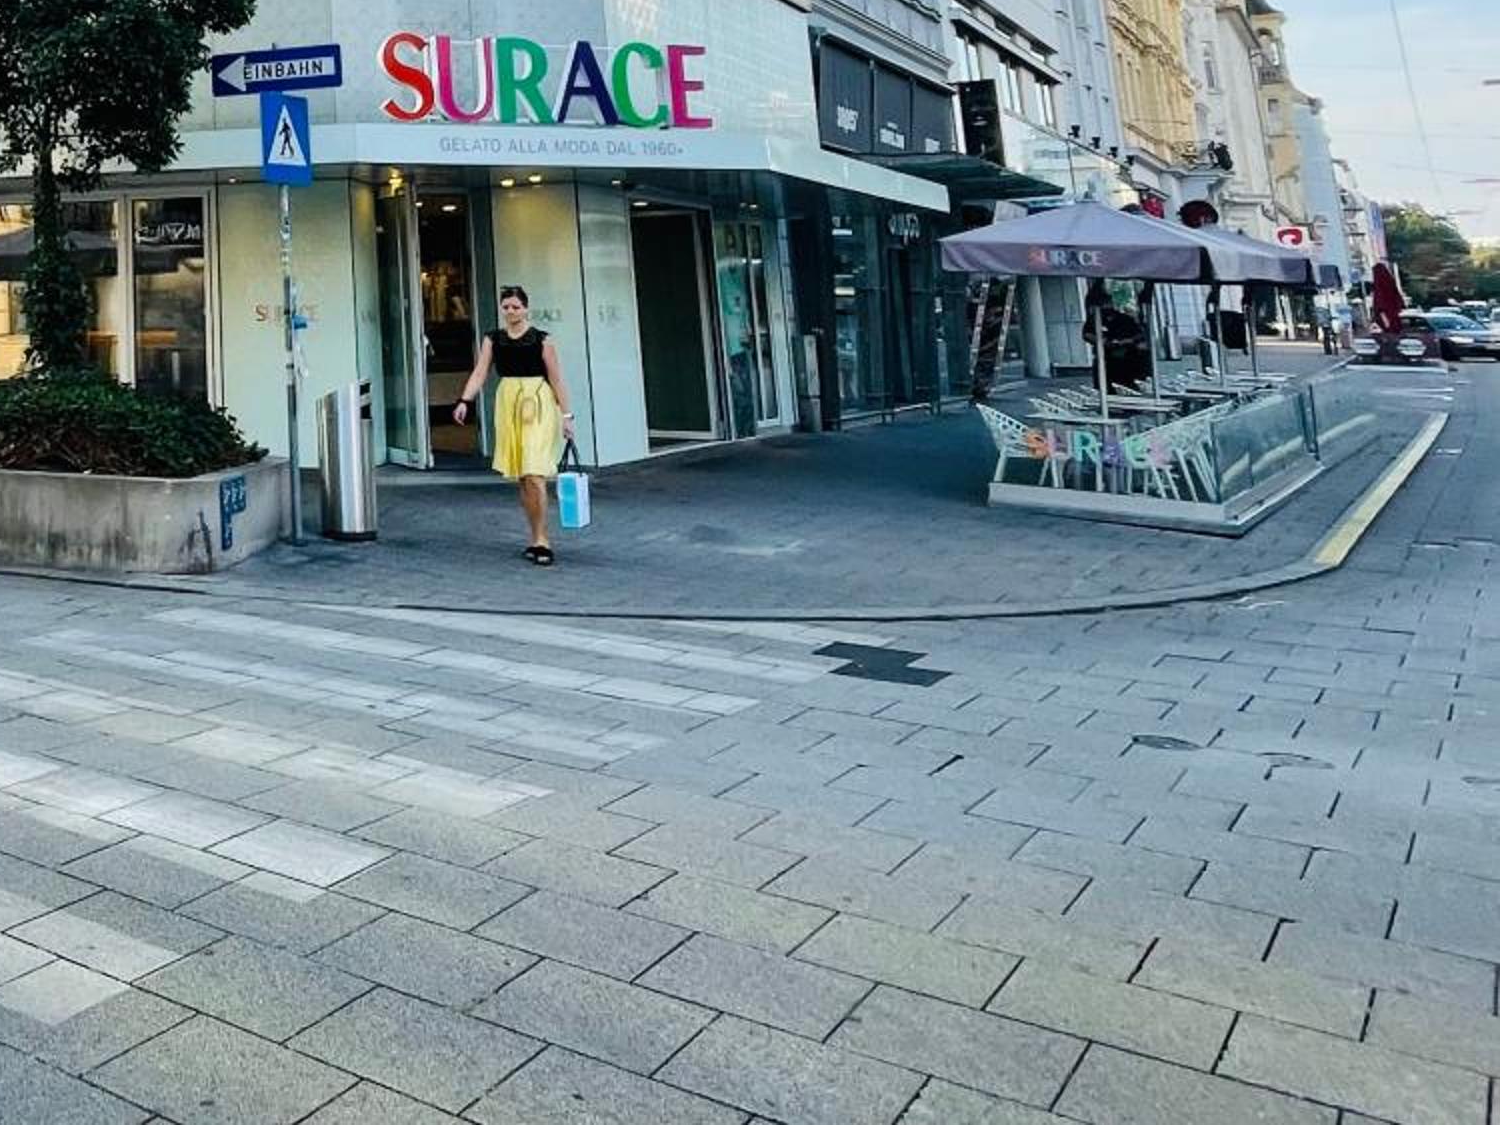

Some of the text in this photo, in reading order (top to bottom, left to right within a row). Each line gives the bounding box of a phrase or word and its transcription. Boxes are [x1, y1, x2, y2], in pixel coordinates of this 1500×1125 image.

[243, 60, 323, 80] EINBAHN
[378, 32, 713, 129] SURACE
[439, 137, 501, 153] GELATO
[507, 138, 548, 154] ALLA
[555, 140, 600, 154] MODA
[606, 140, 636, 156] DAL
